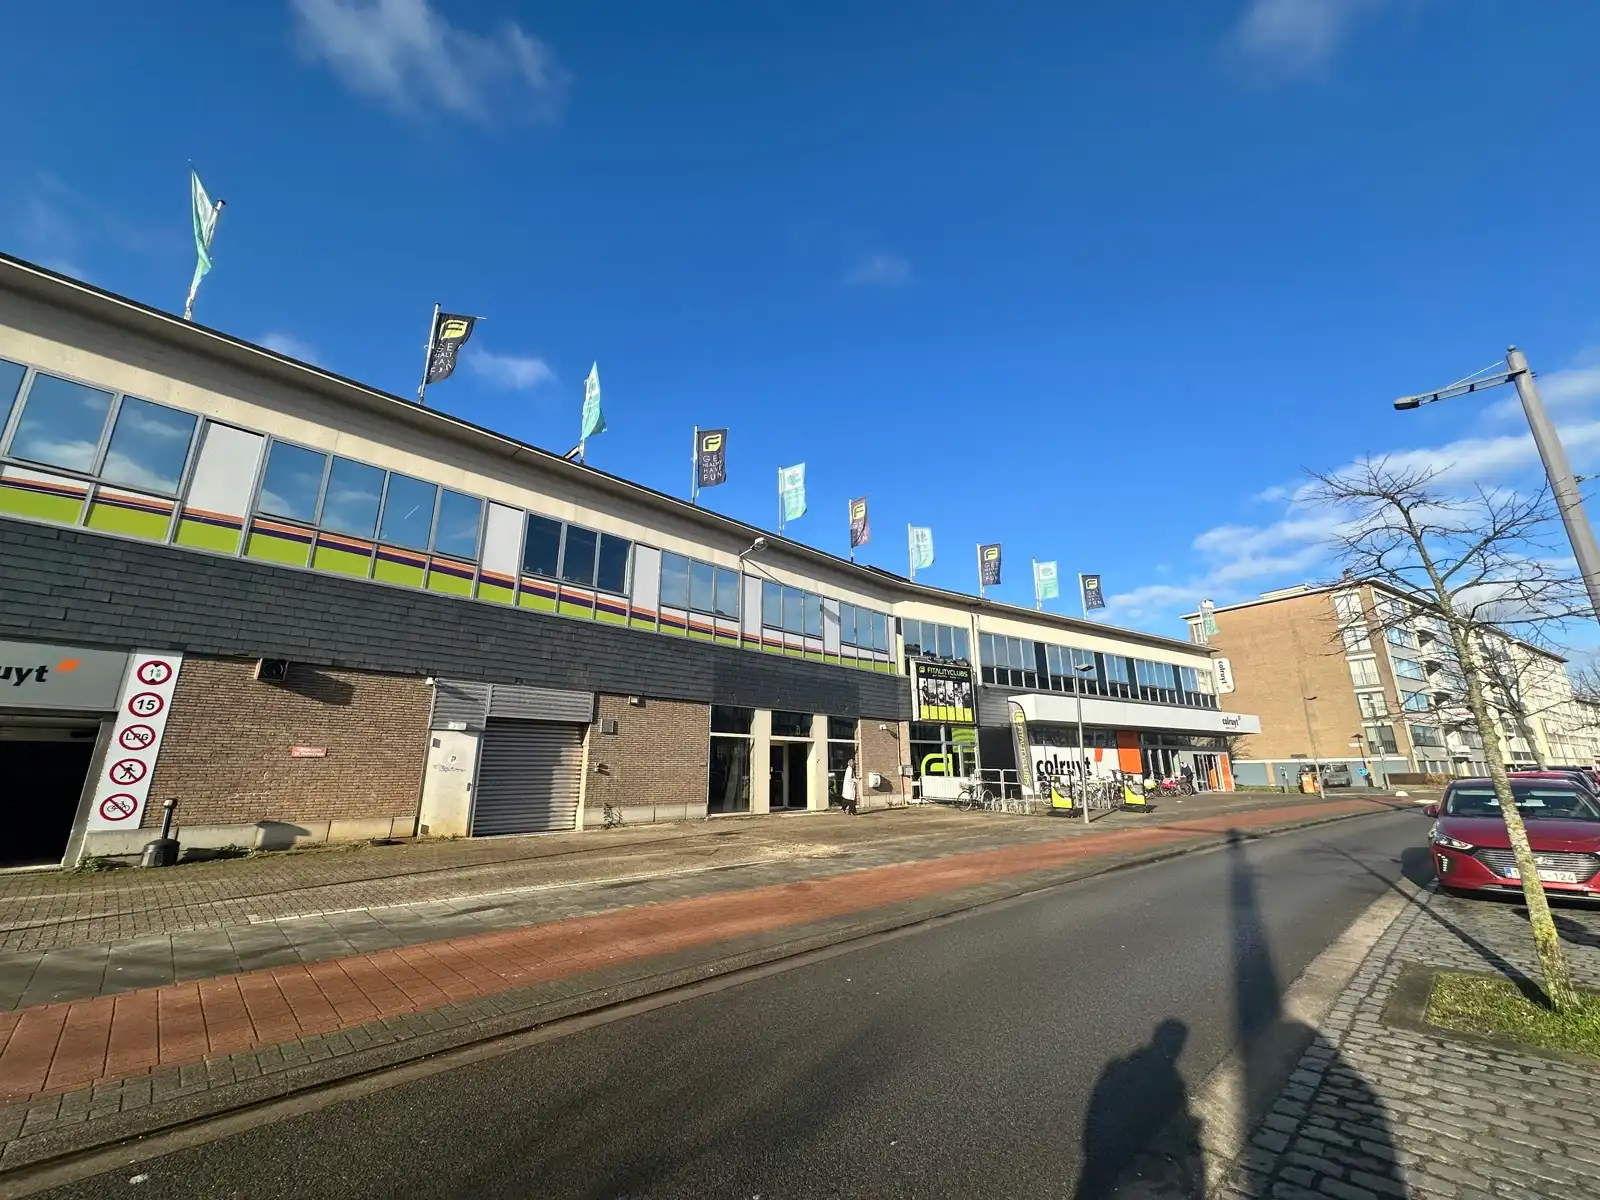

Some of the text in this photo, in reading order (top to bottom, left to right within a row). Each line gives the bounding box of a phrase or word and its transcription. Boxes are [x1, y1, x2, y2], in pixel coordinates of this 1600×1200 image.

[704, 471, 722, 481] FUN
[927, 667, 968, 678] FITALITYCLUBS
[1218, 661, 1227, 684] colruyt
[136, 700, 156, 710] 15
[1222, 717, 1239, 727] colruyt
[125, 733, 149, 741] LPG
[1036, 753, 1092, 780] colruyt
